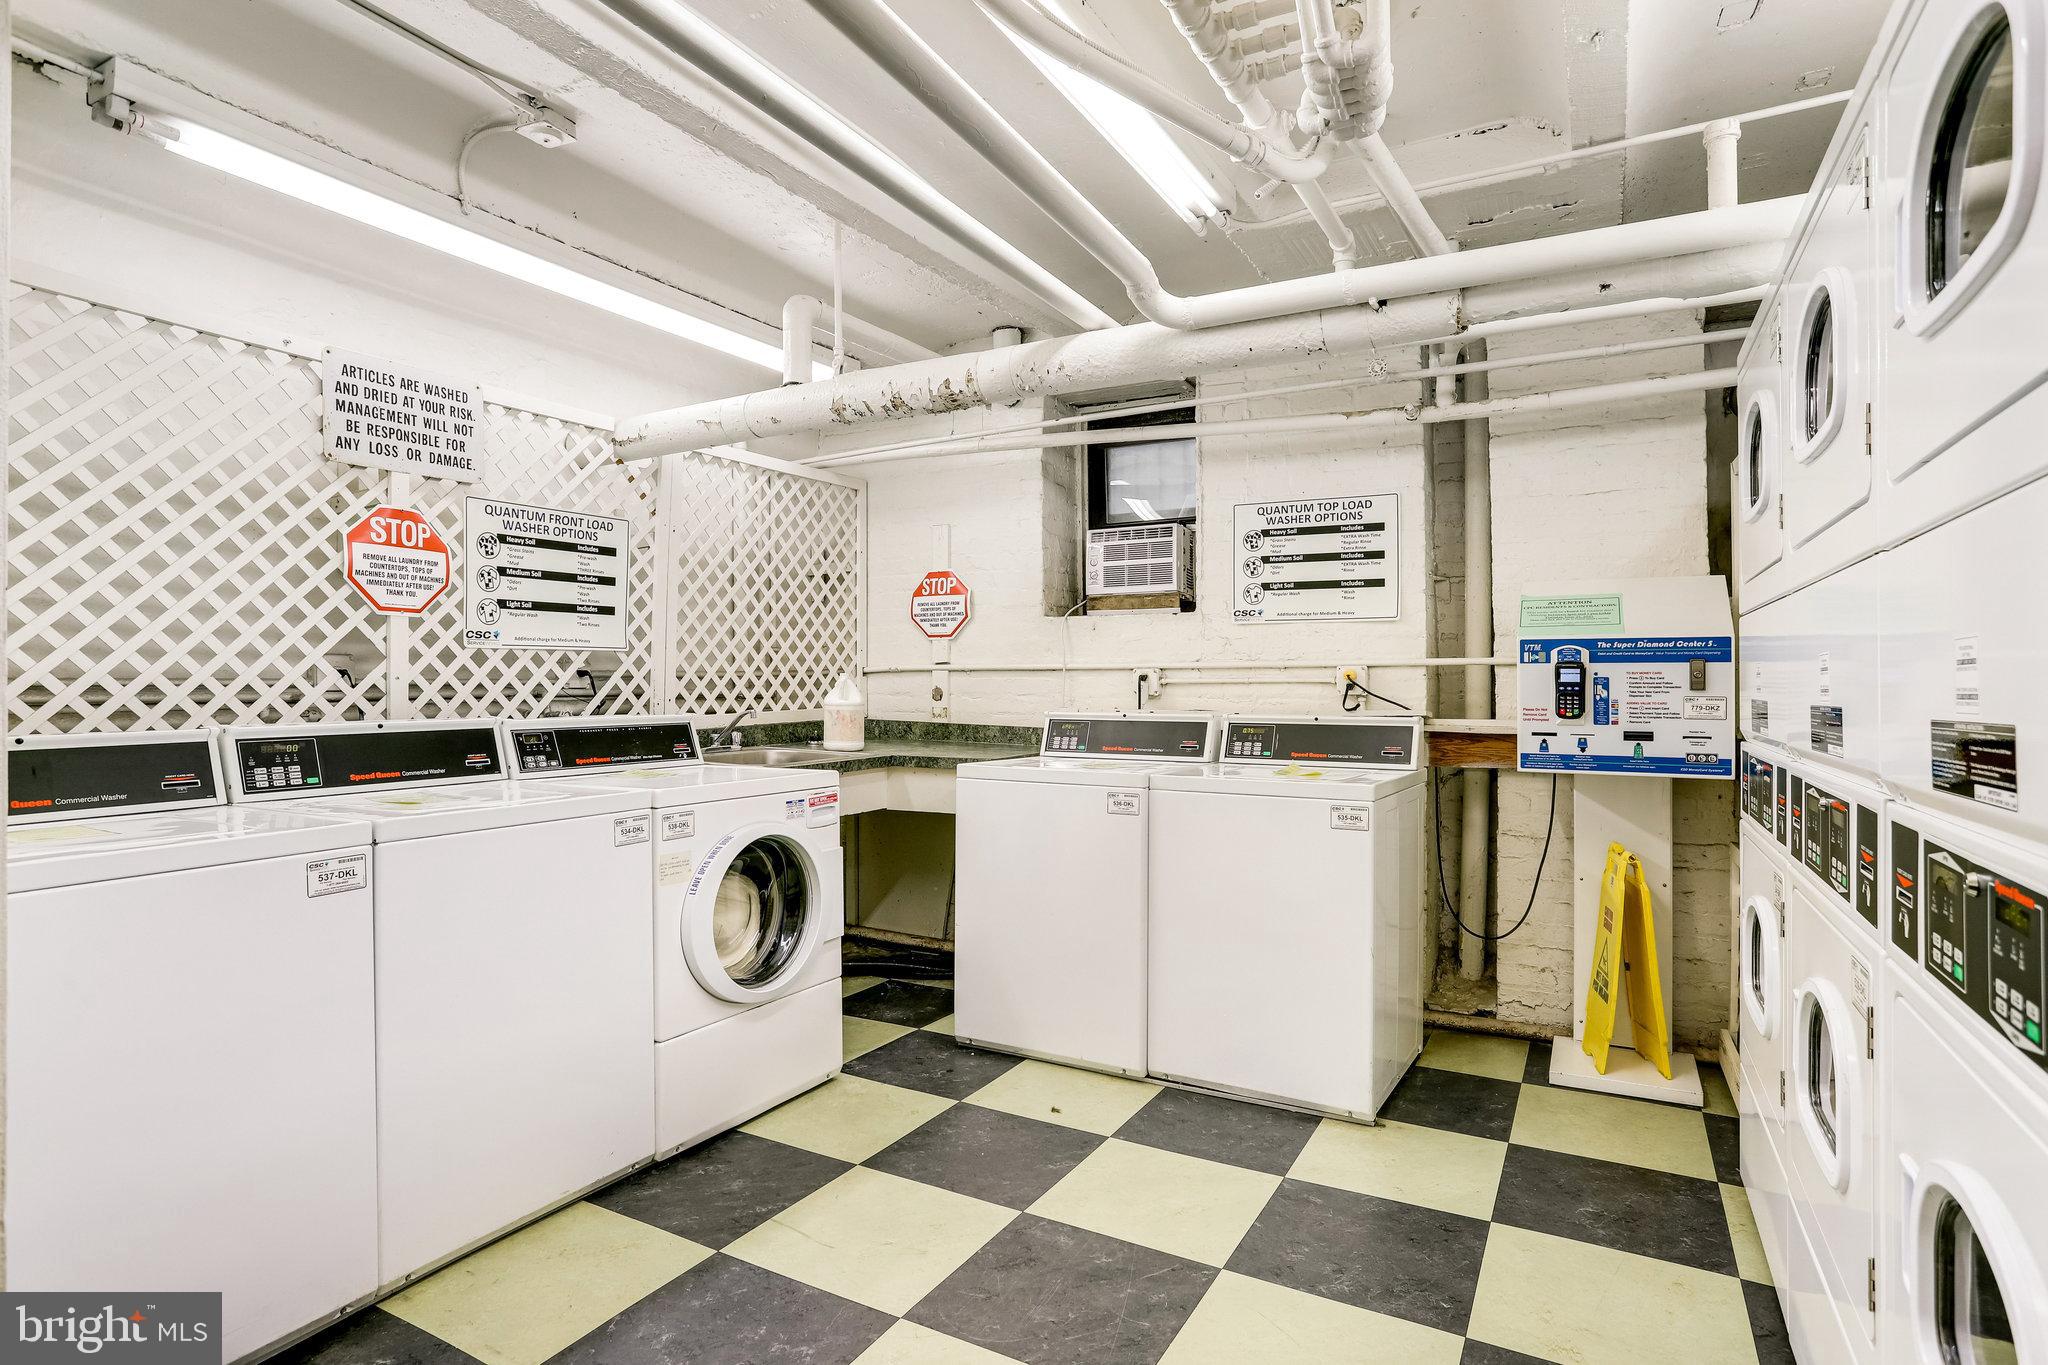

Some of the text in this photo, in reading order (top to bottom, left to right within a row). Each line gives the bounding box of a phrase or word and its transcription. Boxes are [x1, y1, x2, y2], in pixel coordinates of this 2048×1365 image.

[342, 364, 468, 403] ARTICLES ARE WASHED
[335, 381, 475, 421] AND DRIED AT YOUR RISK.
[336, 399, 474, 437] MANAGEMENT WILL NOT
[347, 419, 465, 452] BE RESPONSIBLE FOR
[336, 436, 475, 471] ANY LOSS OR DAMAGE.
[1257, 500, 1372, 516] QUANTUM TOP LOAD
[485, 505, 613, 531] QUANTUM FRONT LOAD
[1266, 511, 1363, 525] WASHER OPTIONS
[370, 516, 430, 548] STOP
[502, 520, 598, 541] WASHER OPTIONS
[507, 536, 535, 545] Heavy Soil
[578, 544, 599, 553] Includes
[363, 553, 386, 561] REMOVE
[399, 557, 423, 565] LAUNDRY
[355, 570, 385, 578] MACHINES
[419, 576, 444, 584] MACHINES
[507, 569, 530, 577] Medium
[577, 575, 598, 583] Includes
[367, 579, 404, 587] IMMEDIATELY
[922, 578, 956, 595] STOP
[466, 630, 491, 639] CSC
[1637, 640, 1674, 648] Diamond
[350, 773, 375, 781] Speed
[377, 771, 400, 779] Queen
[11, 799, 52, 808] Queen
[55, 796, 100, 805] Commercial
[621, 827, 644, 835] 534-DKL
[668, 822, 690, 830] 538-DKL
[318, 869, 357, 882] 537-DKL
[689, 877, 701, 896] LEAVE
[698, 860, 711, 876] OPEN
[708, 845, 723, 860] WHEN
